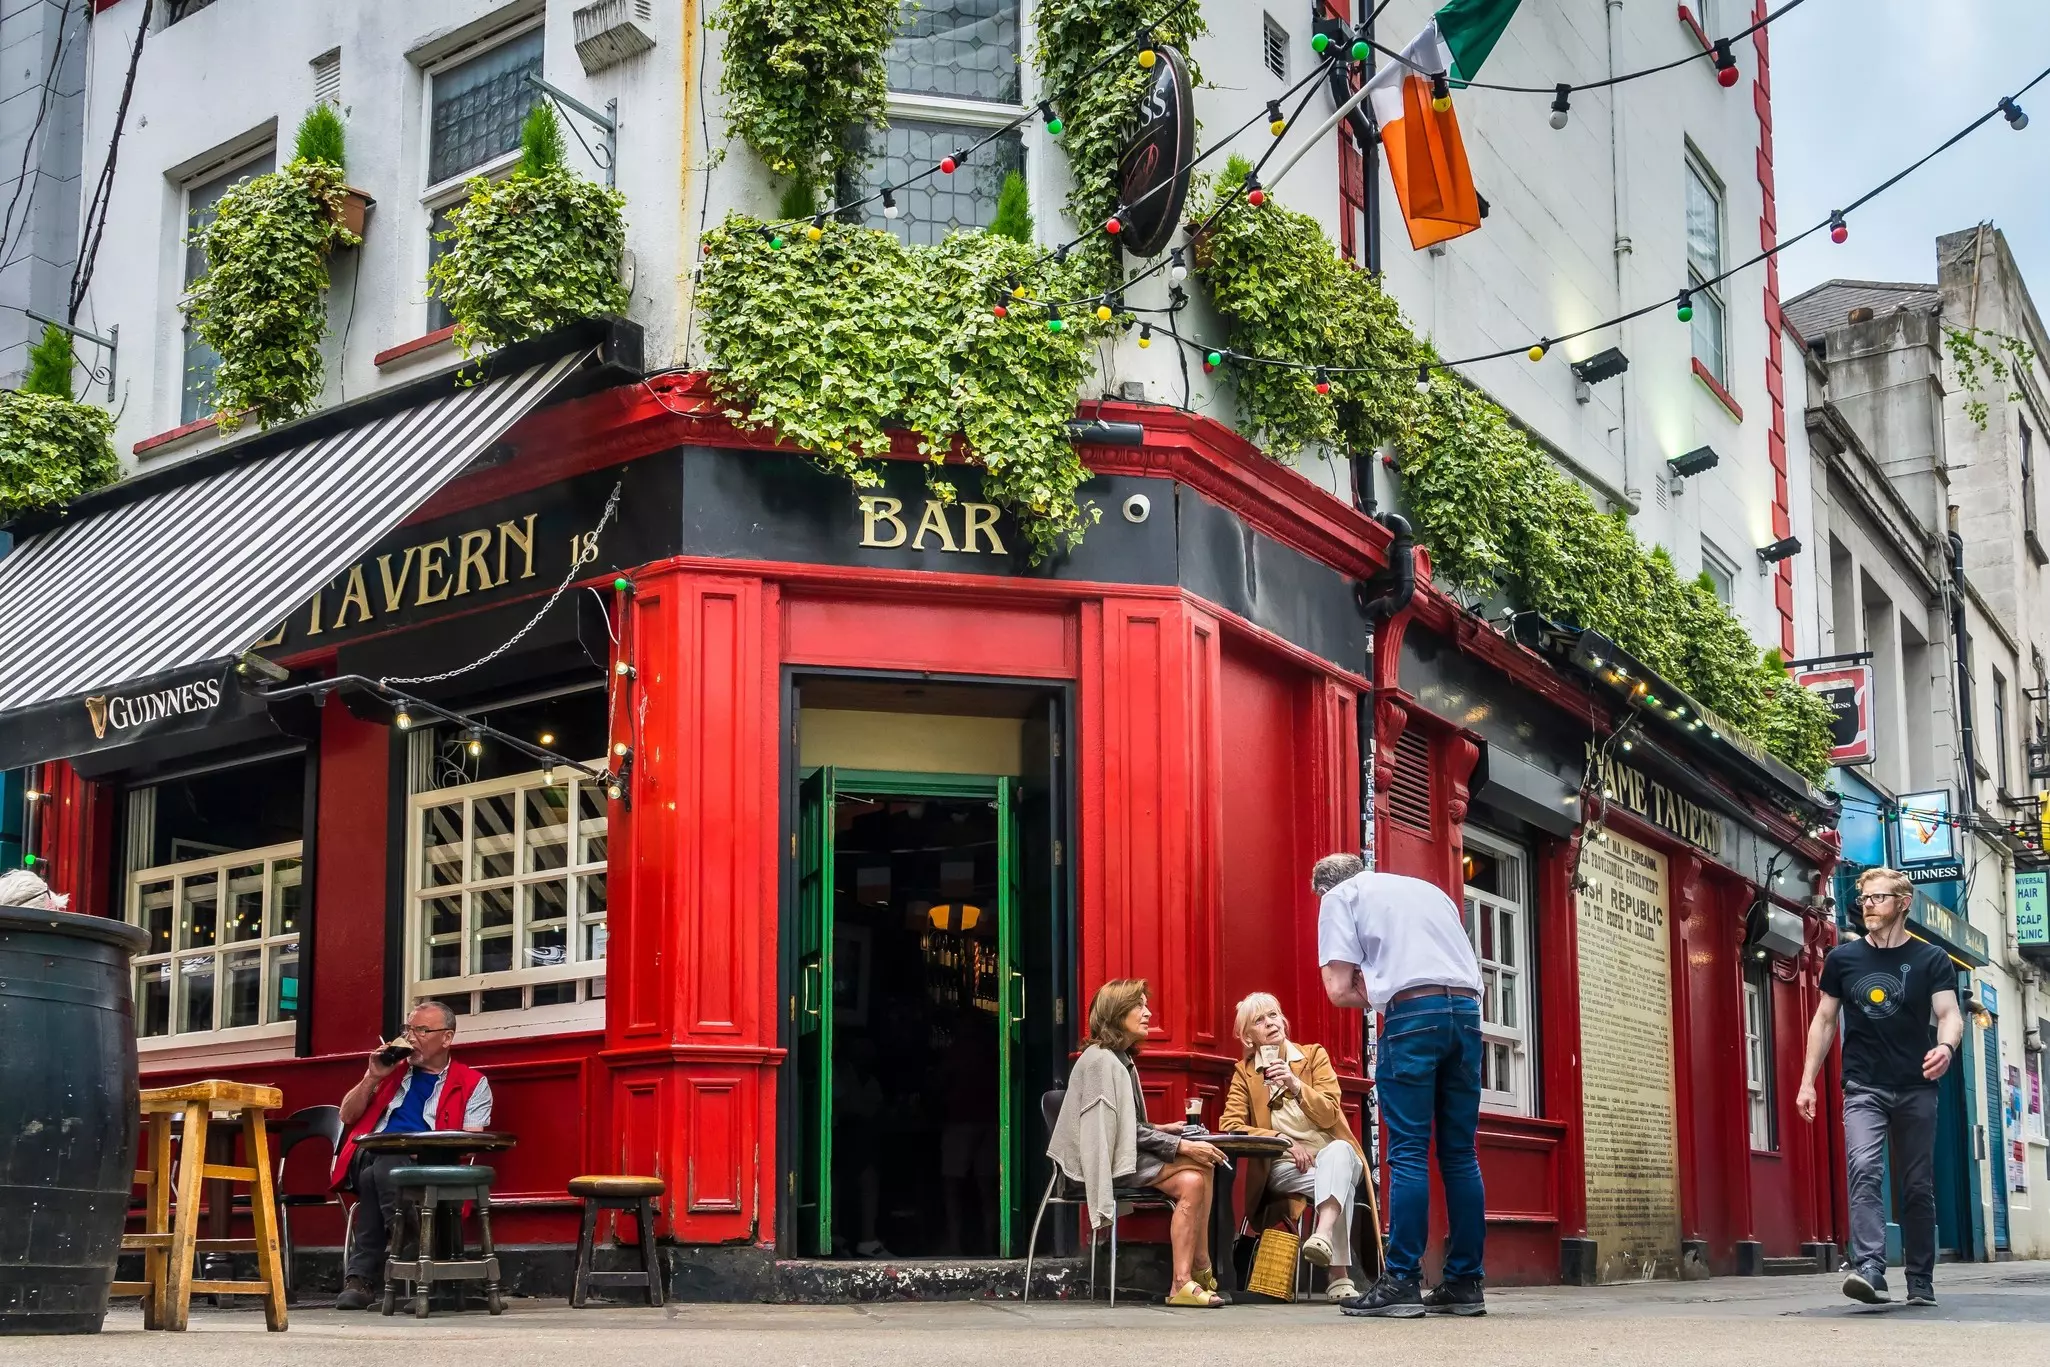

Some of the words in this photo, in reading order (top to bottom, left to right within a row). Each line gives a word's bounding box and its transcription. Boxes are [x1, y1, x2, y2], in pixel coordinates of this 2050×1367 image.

[858, 495, 1008, 555] BAR
[569, 530, 600, 566] 18
[109, 678, 220, 730] GUINNESS
[1650, 780, 1721, 854] TAVERN
[2016, 876, 2044, 885] NIVERSAL
[2017, 887, 2038, 898] HAIR
[1611, 887, 1663, 926] REPUBLIC
[2016, 914, 2042, 926] SCALP
[2025, 901, 2031, 911] &
